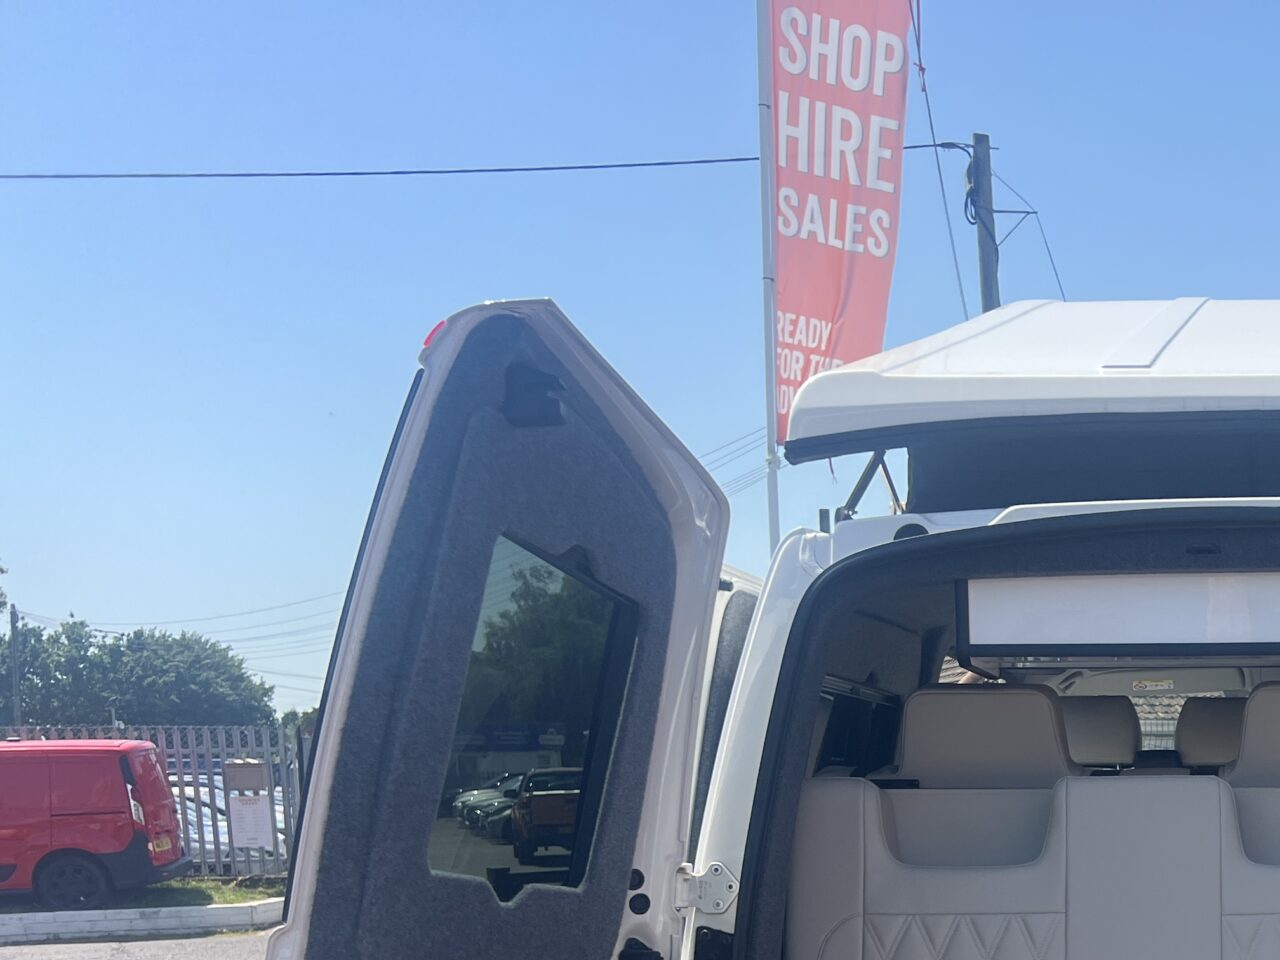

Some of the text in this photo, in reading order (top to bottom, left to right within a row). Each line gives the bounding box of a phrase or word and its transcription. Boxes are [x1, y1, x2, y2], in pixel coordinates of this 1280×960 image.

[778, 6, 905, 97] SHOP
[777, 89, 901, 193] HIRE
[777, 186, 891, 258] SALES
